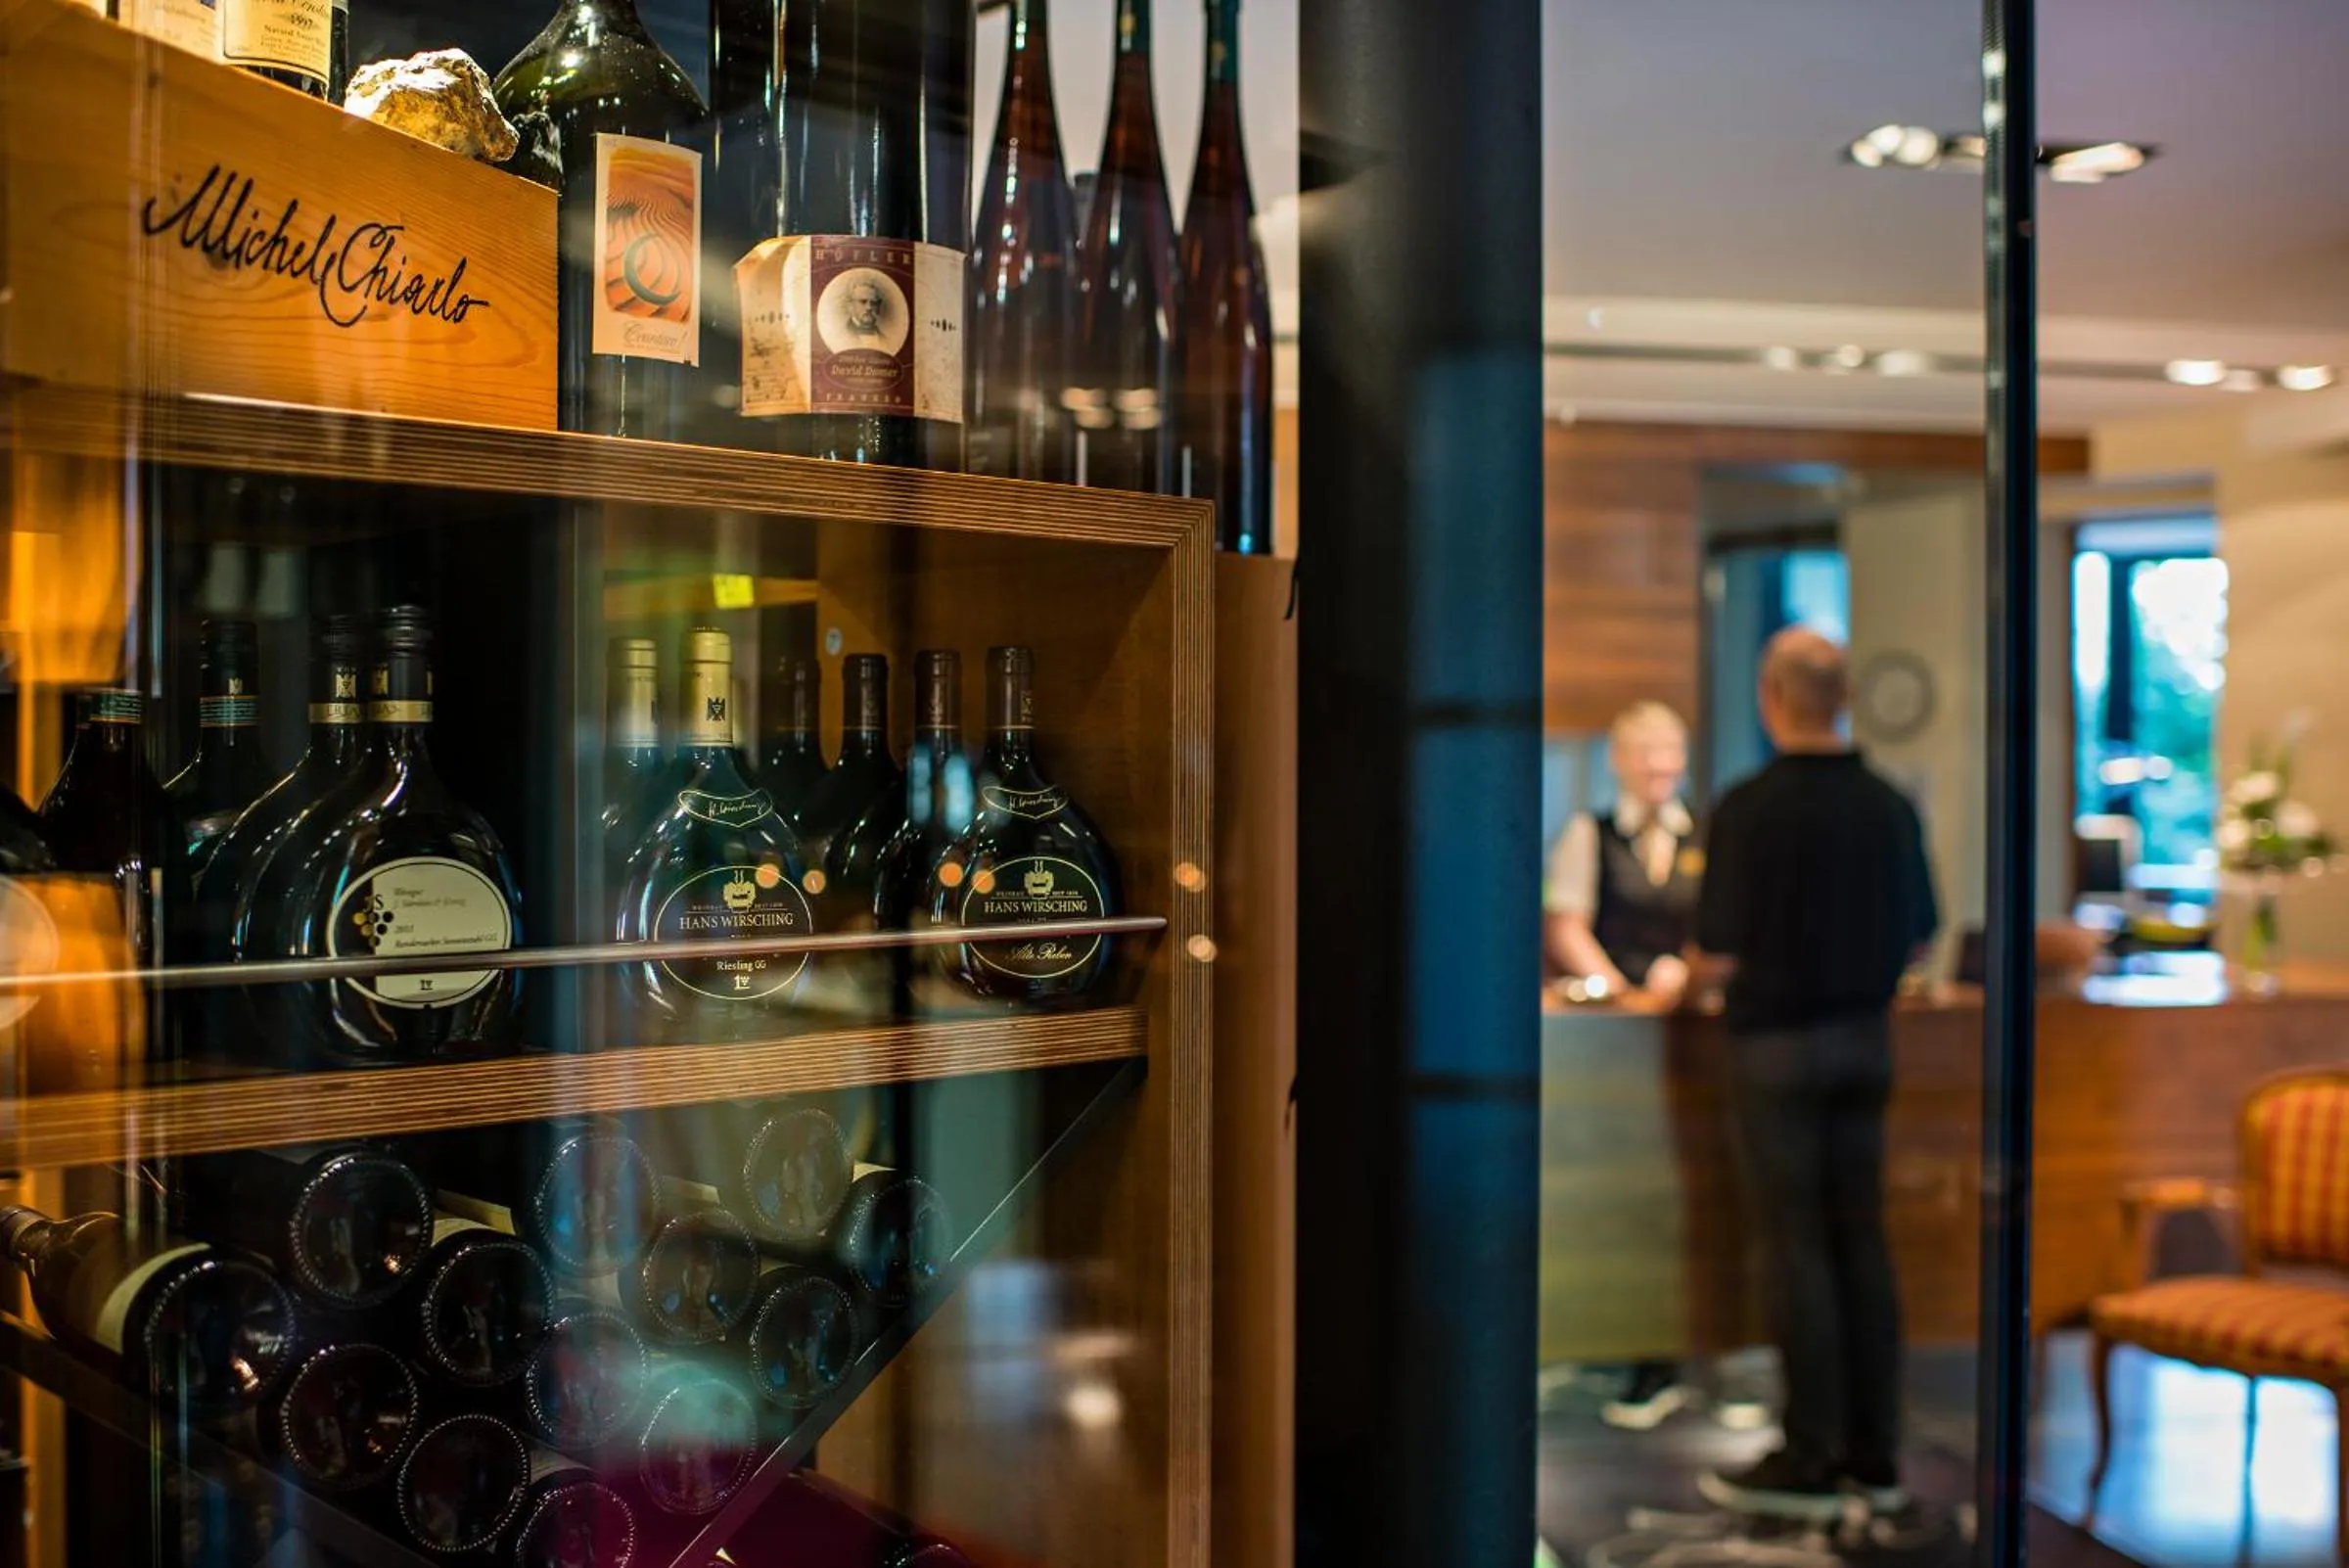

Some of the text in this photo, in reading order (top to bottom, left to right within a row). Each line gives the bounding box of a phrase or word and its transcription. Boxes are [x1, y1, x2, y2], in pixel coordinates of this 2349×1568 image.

[338, 222, 489, 324] Chiarlo
[984, 899, 1088, 913] HANS WIRSCHING
[679, 912, 794, 930] HANS WIRSCHING
[715, 959, 754, 972] Riesling
